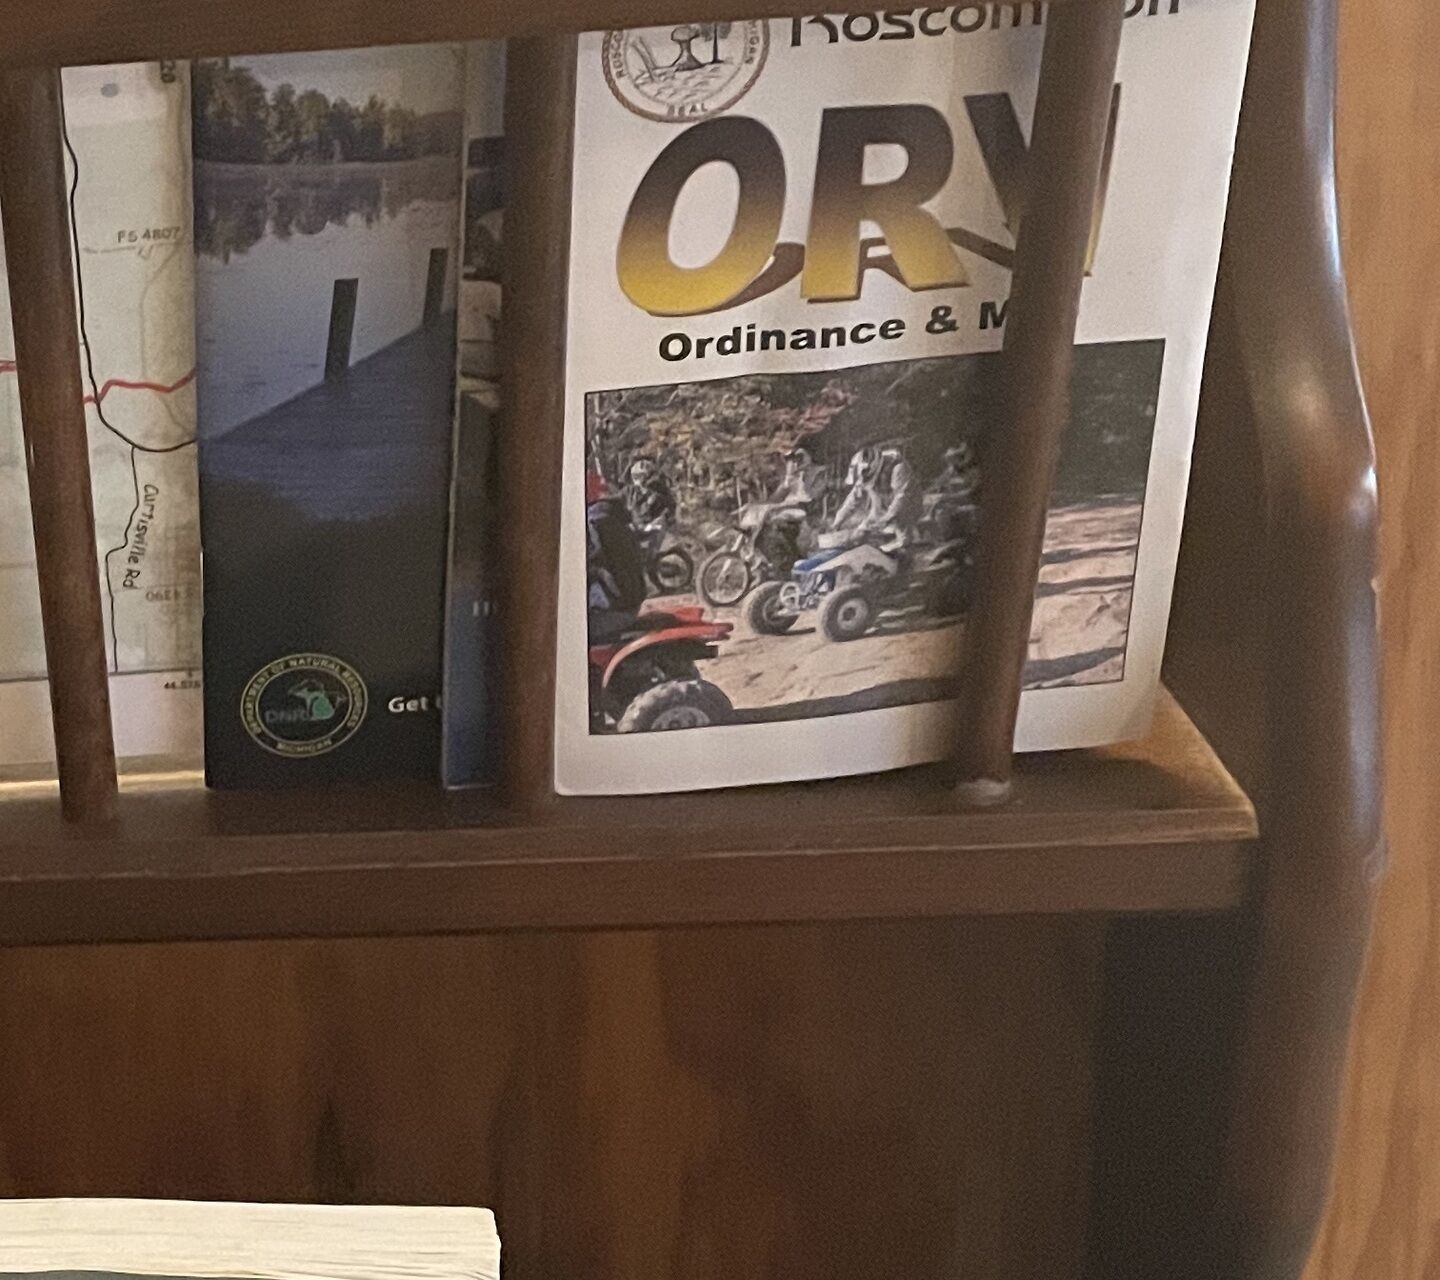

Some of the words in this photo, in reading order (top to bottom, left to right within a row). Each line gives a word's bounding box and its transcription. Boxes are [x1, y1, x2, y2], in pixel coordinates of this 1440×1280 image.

[658, 313, 907, 362] Ordinance
[925, 305, 961, 336] &
[128, 482, 160, 565] Curtisville
[122, 567, 142, 591] Rd
[288, 657, 342, 673] NATURAL
[387, 696, 428, 713] Get
